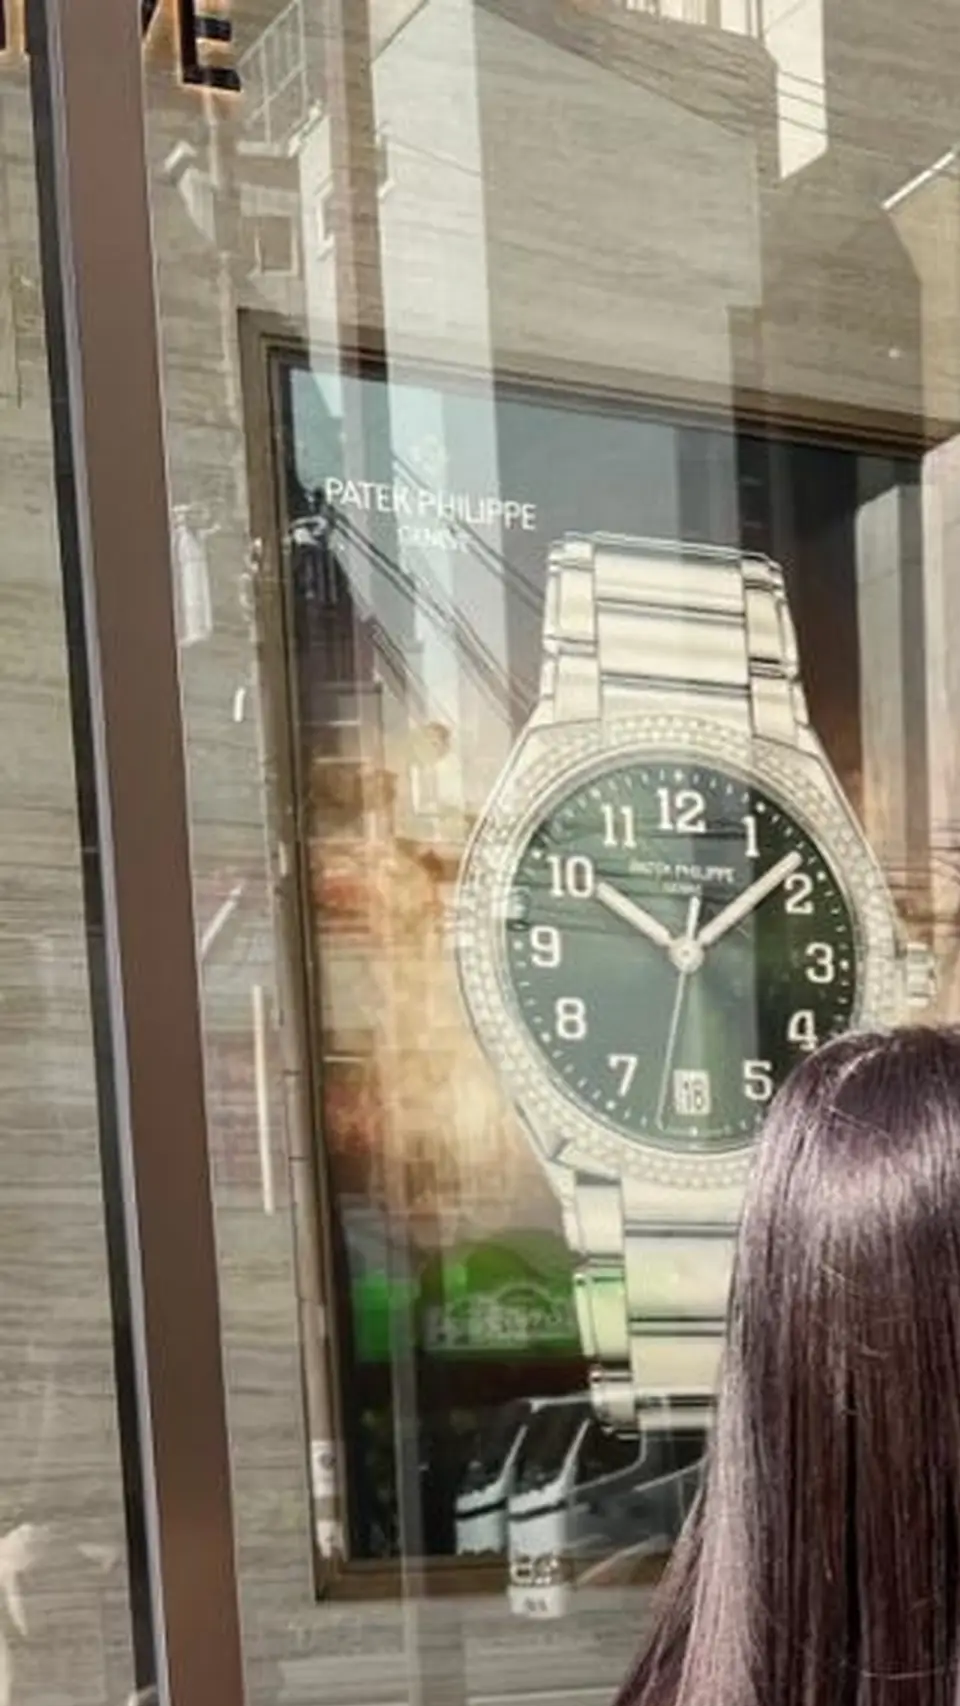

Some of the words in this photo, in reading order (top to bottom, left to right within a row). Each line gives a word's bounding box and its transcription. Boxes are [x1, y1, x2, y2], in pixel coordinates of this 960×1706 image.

[141, 0, 242, 92] E
[325, 477, 412, 515] PATEK
[417, 490, 537, 530] PHILIPPE
[601, 804, 637, 849] 11
[657, 787, 706, 834] 12
[742, 815, 760, 858] 1
[546, 855, 594, 898] 10
[783, 873, 814, 915] 2
[530, 926, 560, 968] 9
[805, 942, 835, 984] 3
[555, 997, 587, 1041] 8
[787, 1010, 818, 1051] 4
[606, 1054, 638, 1097] 7
[742, 1060, 773, 1101] 5
